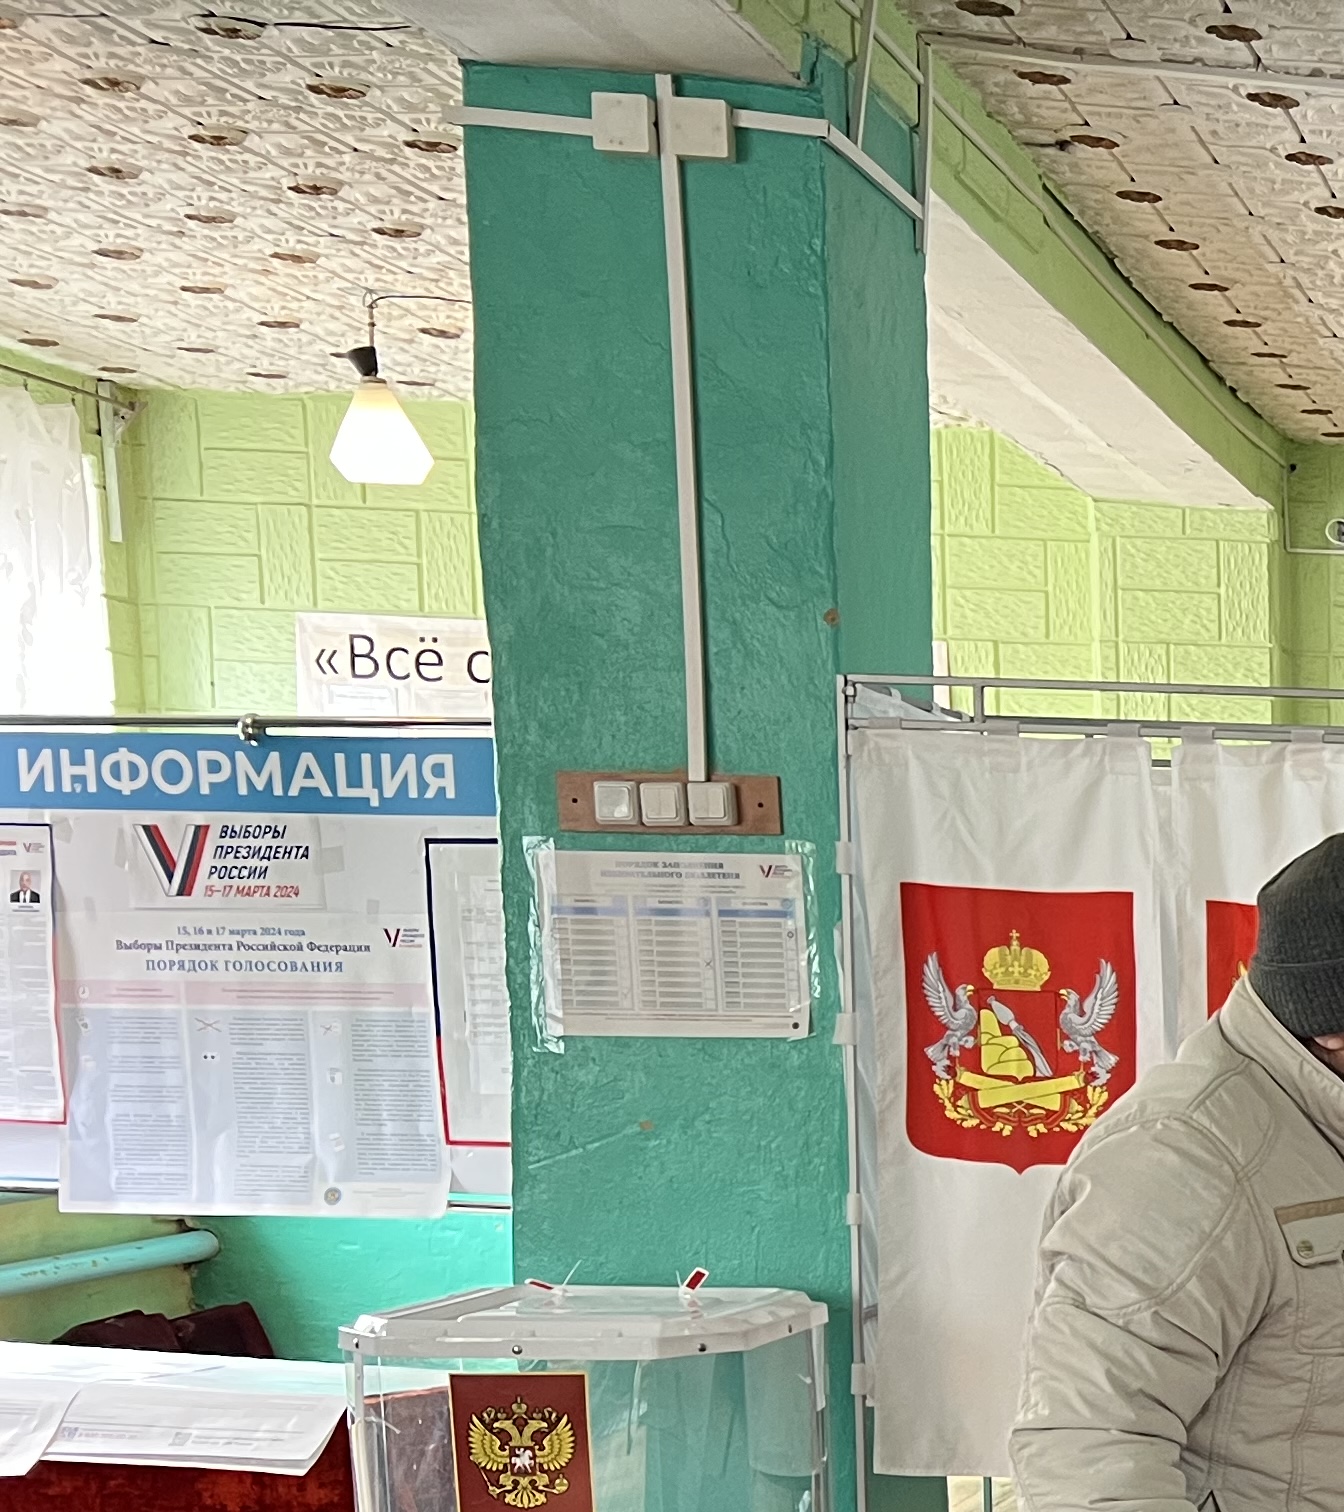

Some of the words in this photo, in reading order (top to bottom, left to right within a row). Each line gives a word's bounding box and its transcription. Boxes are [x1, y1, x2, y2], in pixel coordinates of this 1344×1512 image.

[315, 633, 444, 683] «Всё
[17, 746, 455, 808] ИНФОРМАЦИЯ
[219, 824, 287, 839] ВЫБОРЫ
[212, 845, 310, 862] ПРЕЗИДЕНТА
[207, 865, 269, 880] РОССИИ
[234, 885, 271, 898] МАРТА
[273, 885, 300, 898] 2024
[193, 926, 204, 936] 16
[215, 926, 225, 936] 17
[228, 928, 257, 938] марта
[260, 927, 282, 936] 2024
[284, 928, 306, 937] года
[115, 940, 162, 954] Выборы
[165, 940, 233, 954] Президента
[236, 941, 304, 952] Российской
[306, 941, 371, 955] Федерации
[145, 959, 218, 973] ПОРЯДОК
[224, 960, 344, 973] ГОЛОСОВАНИЯ
